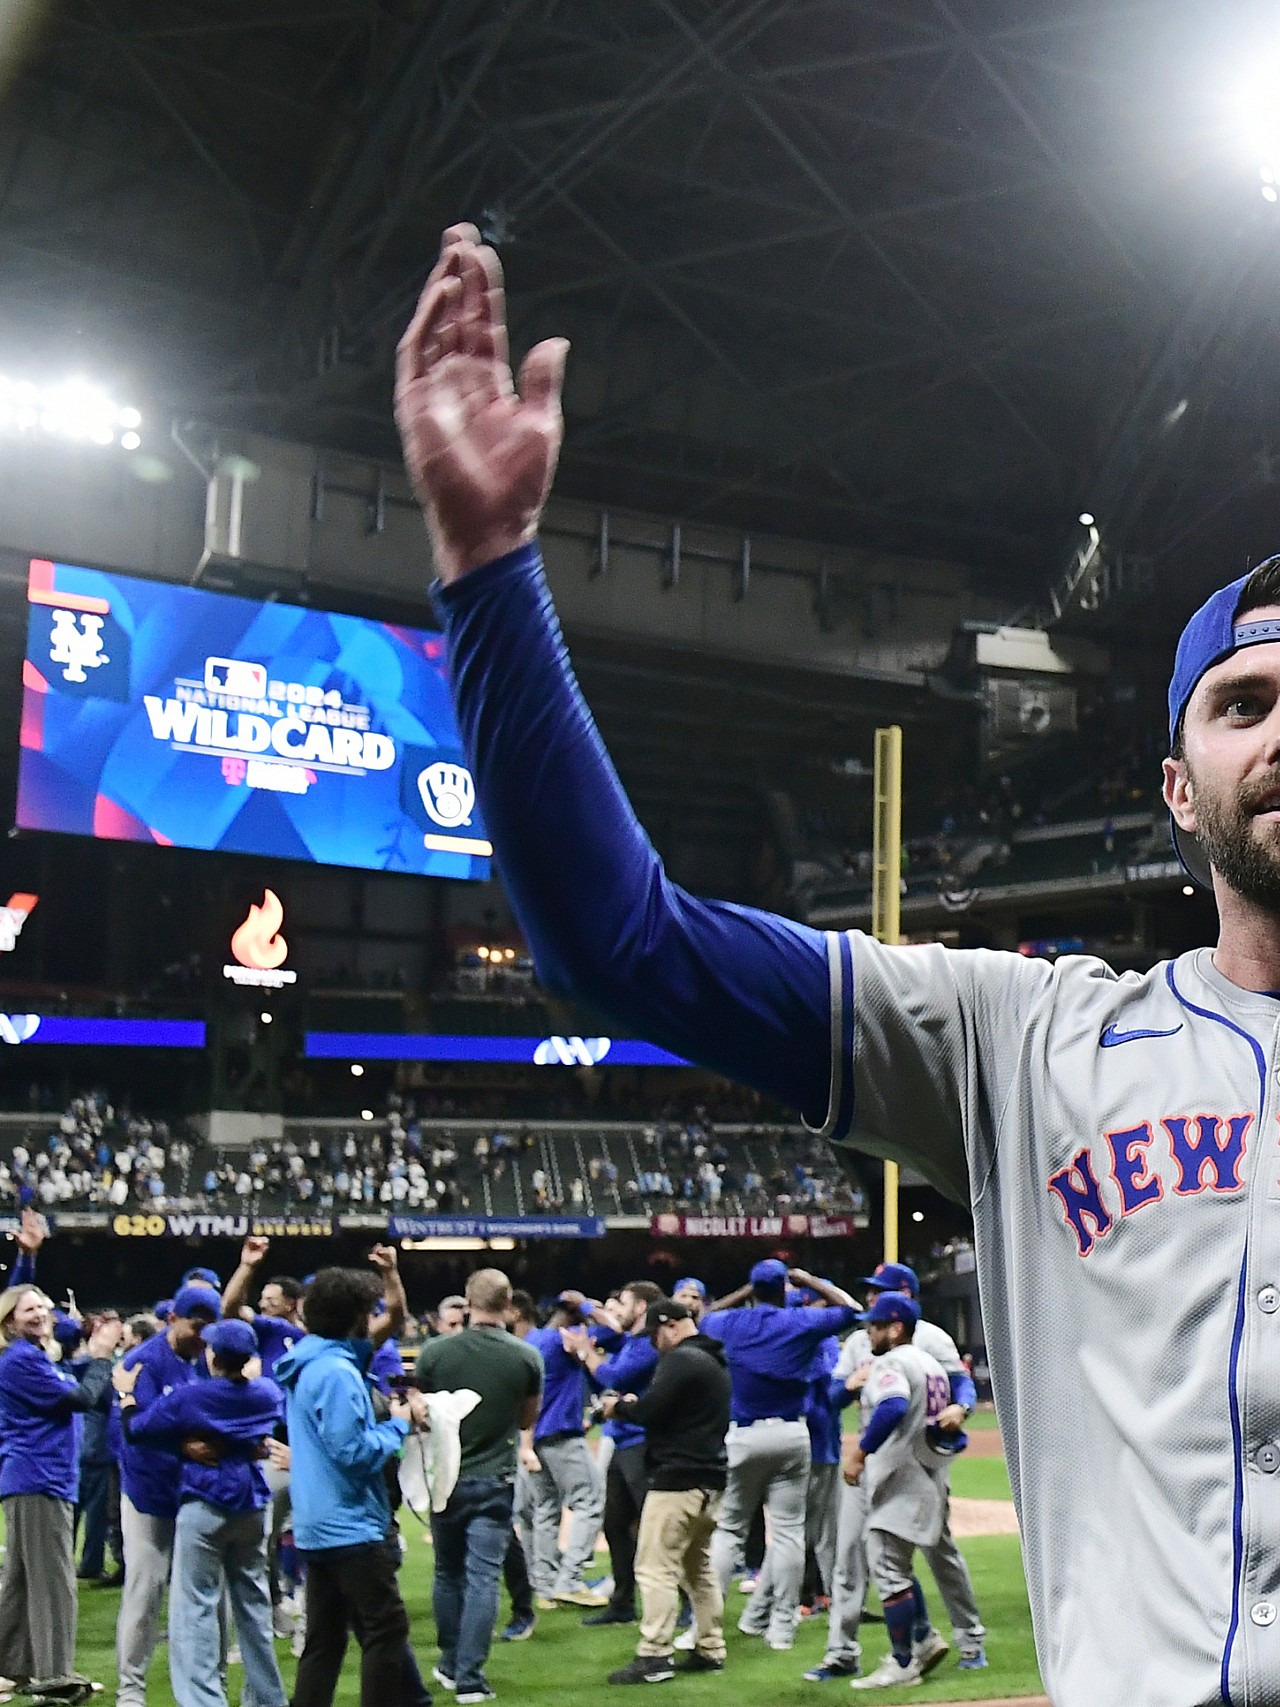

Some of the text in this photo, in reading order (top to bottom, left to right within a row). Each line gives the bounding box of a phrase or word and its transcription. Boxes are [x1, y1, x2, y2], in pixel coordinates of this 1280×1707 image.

[175, 686, 371, 731] NATIONAL LEAGUE
[268, 680, 342, 709] 2024
[1048, 1112, 1255, 1257] NEW
[113, 1214, 249, 1236] 620 WTMJ
